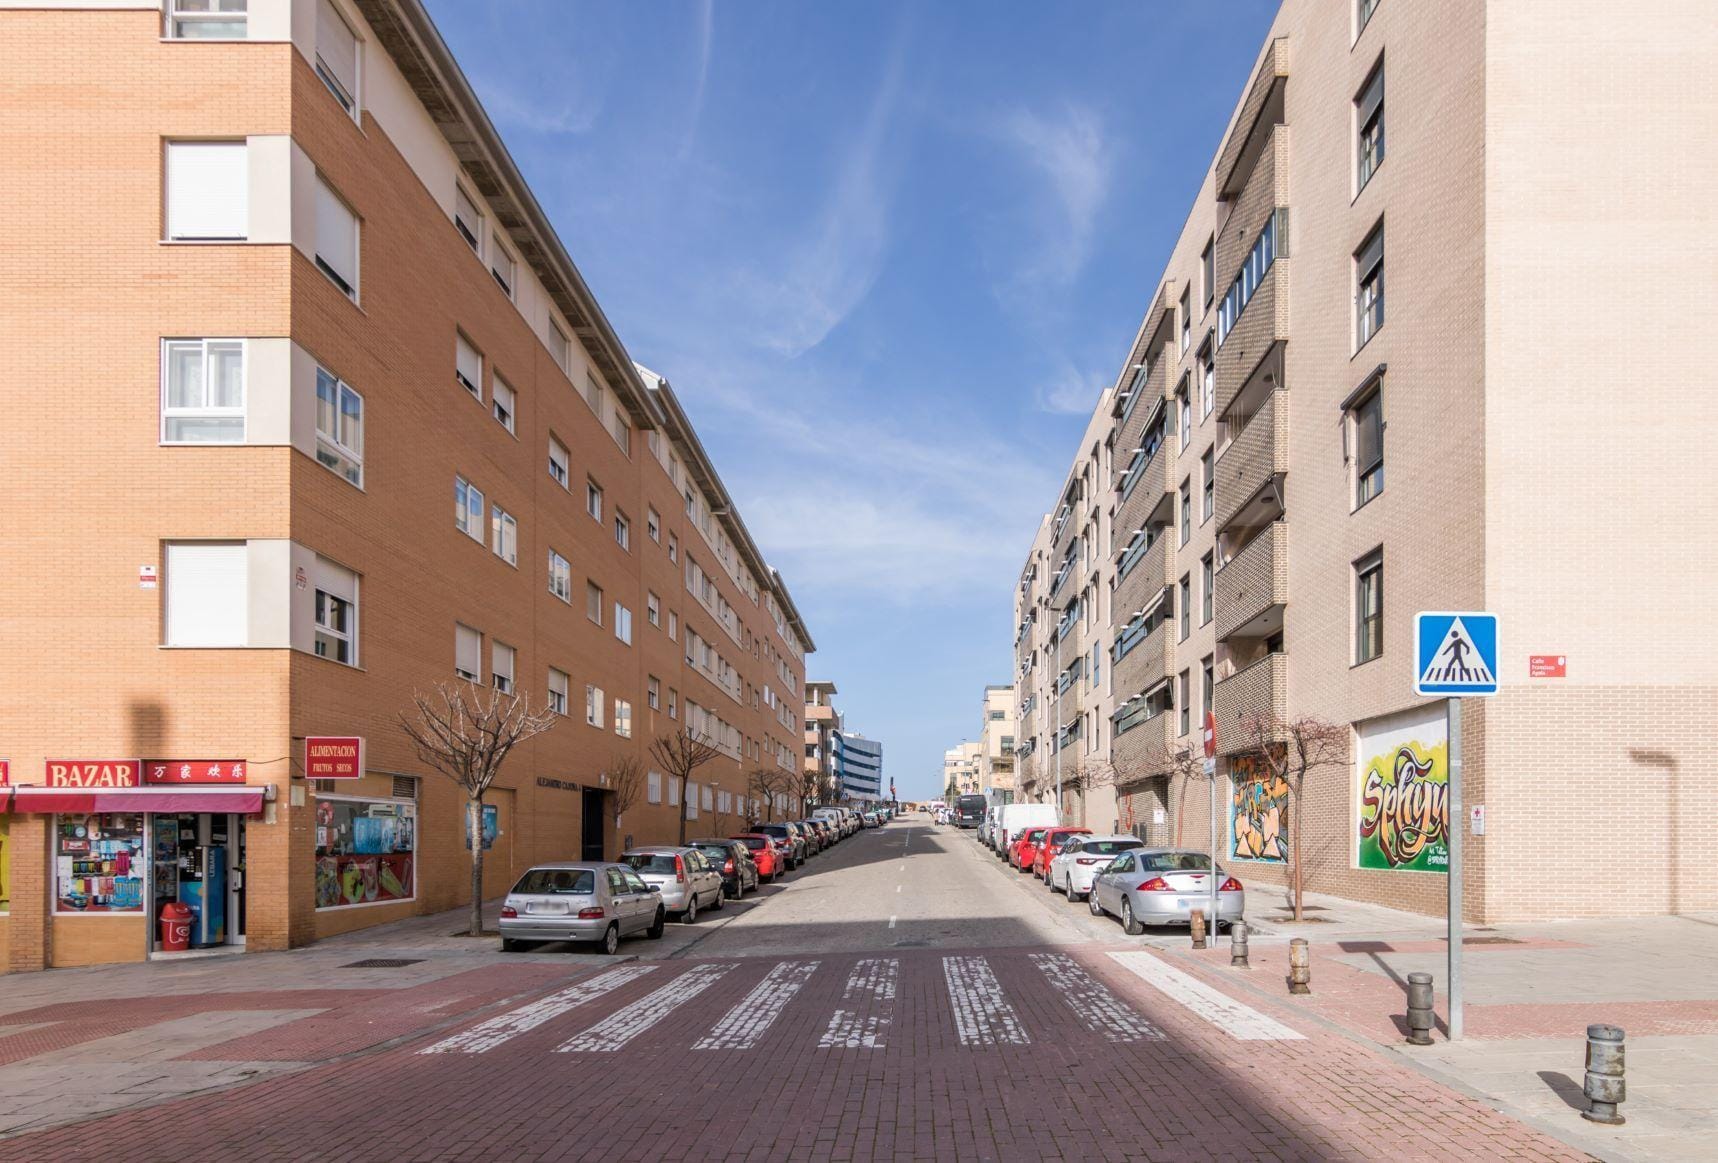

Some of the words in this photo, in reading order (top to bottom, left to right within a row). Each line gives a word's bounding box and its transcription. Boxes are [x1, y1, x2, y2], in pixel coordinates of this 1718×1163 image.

[309, 746, 356, 757] ALIMENTACION
[312, 763, 333, 772] FRUTOS
[336, 763, 352, 772] SECOS
[51, 765, 132, 787] BAZAR
